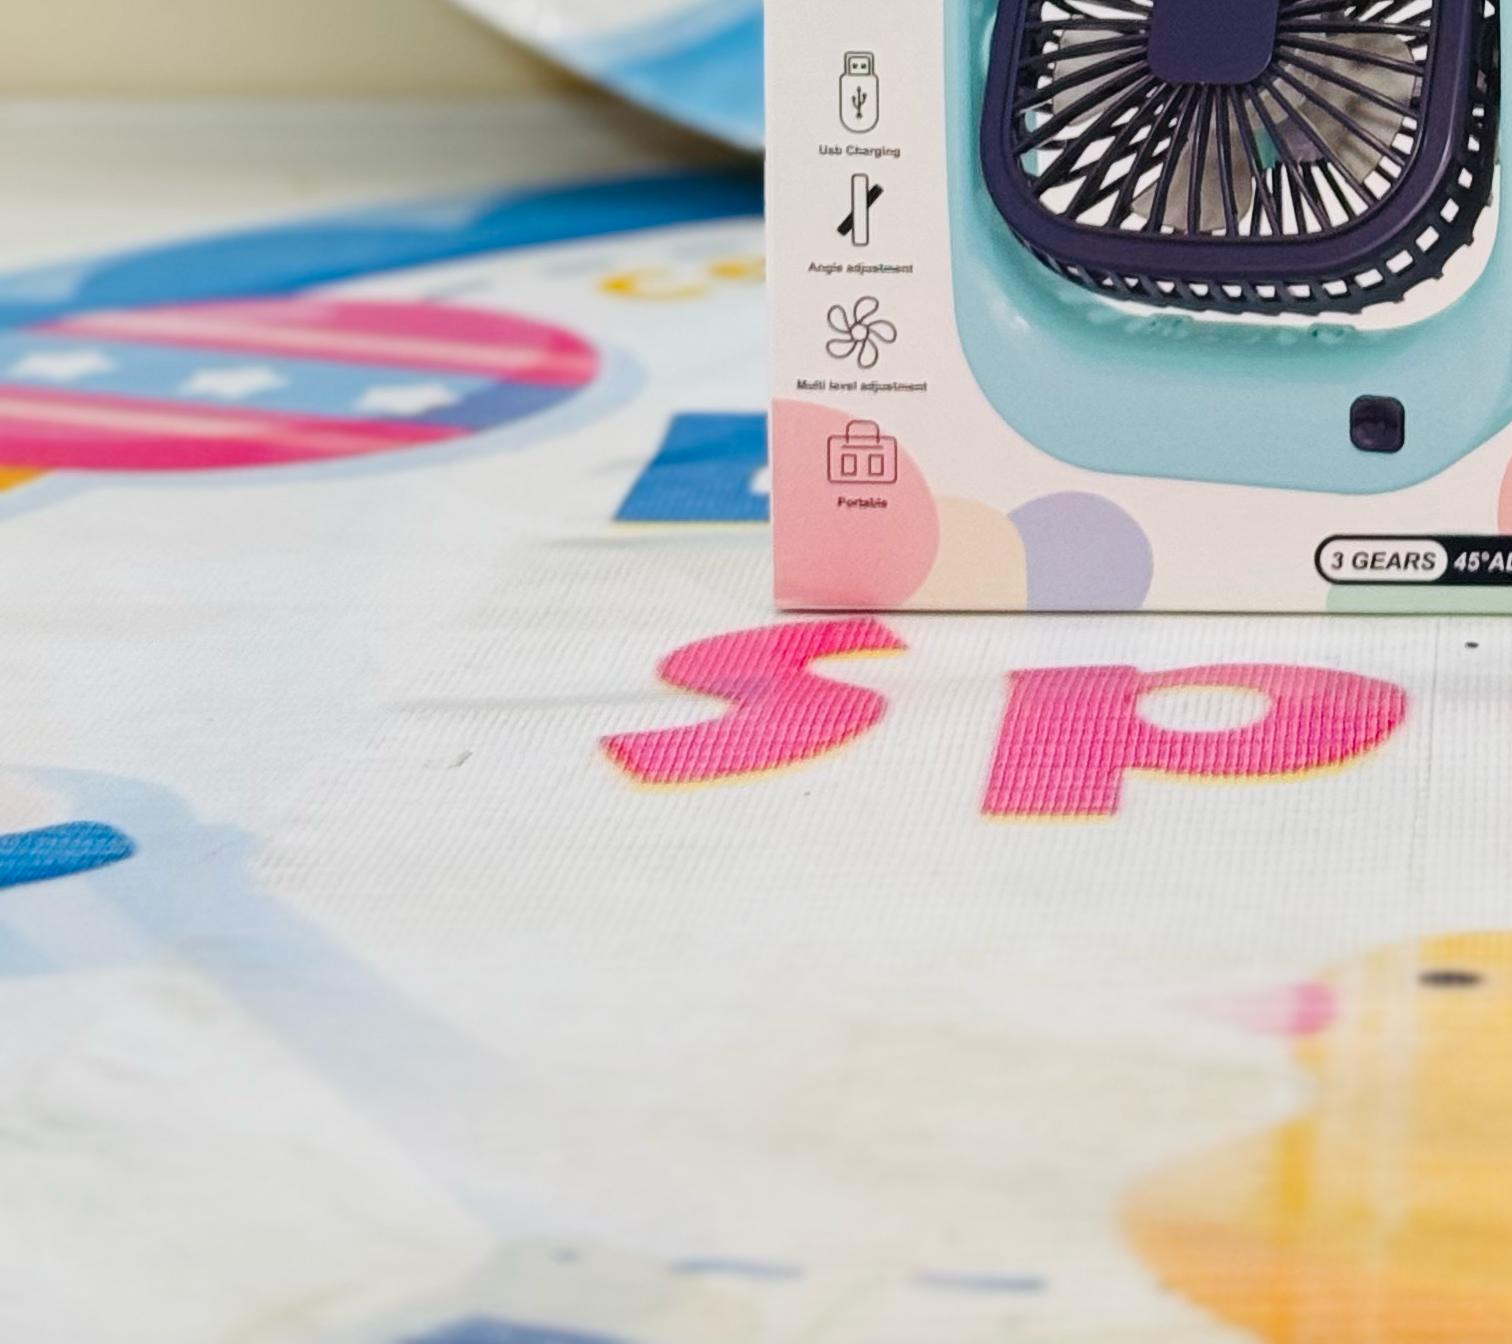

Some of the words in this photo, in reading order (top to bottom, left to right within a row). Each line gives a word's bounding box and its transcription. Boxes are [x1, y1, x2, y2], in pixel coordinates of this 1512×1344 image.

[818, 144, 843, 156] Usb
[845, 145, 901, 159] Charging
[808, 262, 843, 275] Angle
[846, 263, 914, 275] adjustment
[796, 378, 826, 391] Multi
[828, 380, 858, 392] level
[860, 380, 928, 394] adjustment
[837, 496, 888, 509] Portable
[1331, 551, 1344, 571] 3
[1351, 551, 1438, 571] GEARS
